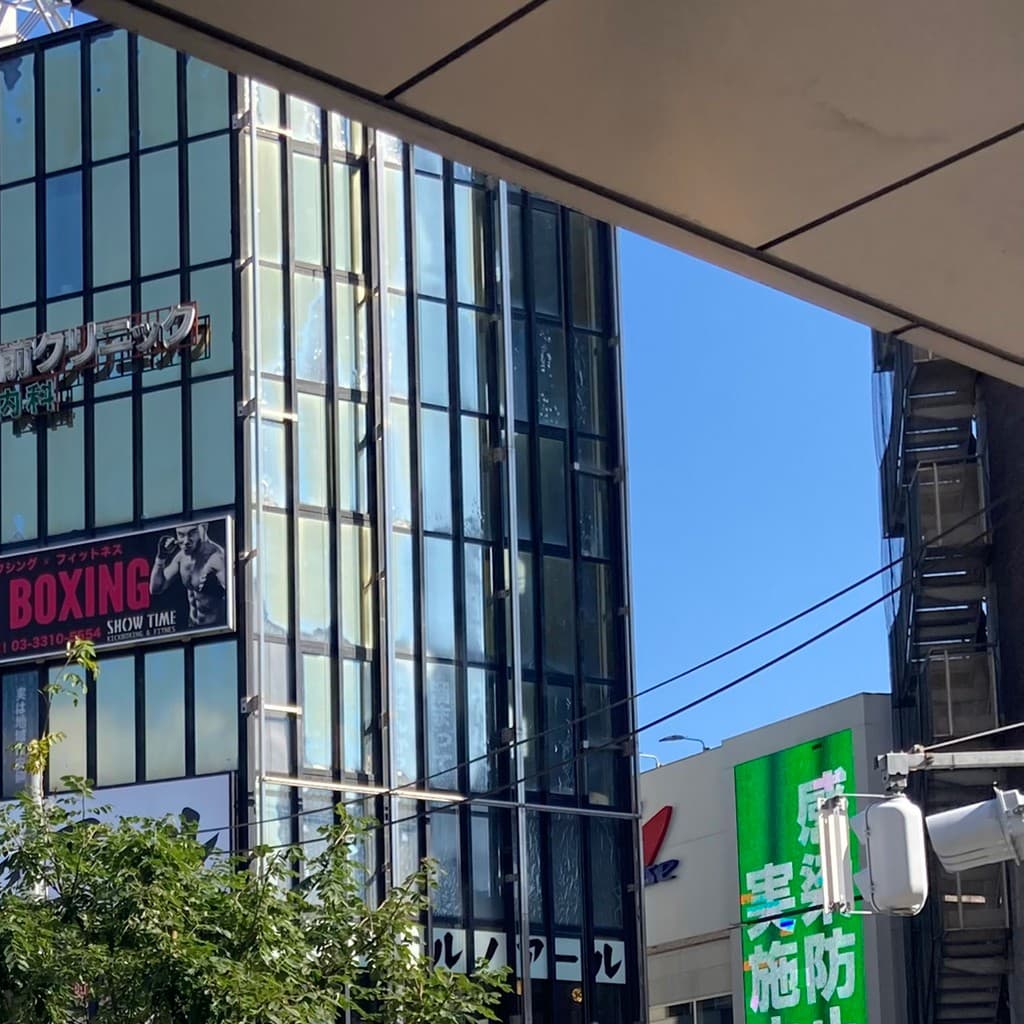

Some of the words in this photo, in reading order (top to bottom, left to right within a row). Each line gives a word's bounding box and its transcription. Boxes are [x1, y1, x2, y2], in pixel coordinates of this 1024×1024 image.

[9, 558, 150, 631] BOXING
[107, 616, 143, 635] SHOW
[147, 610, 176, 628] TIME
[433, 931, 623, 980] ルノアール
